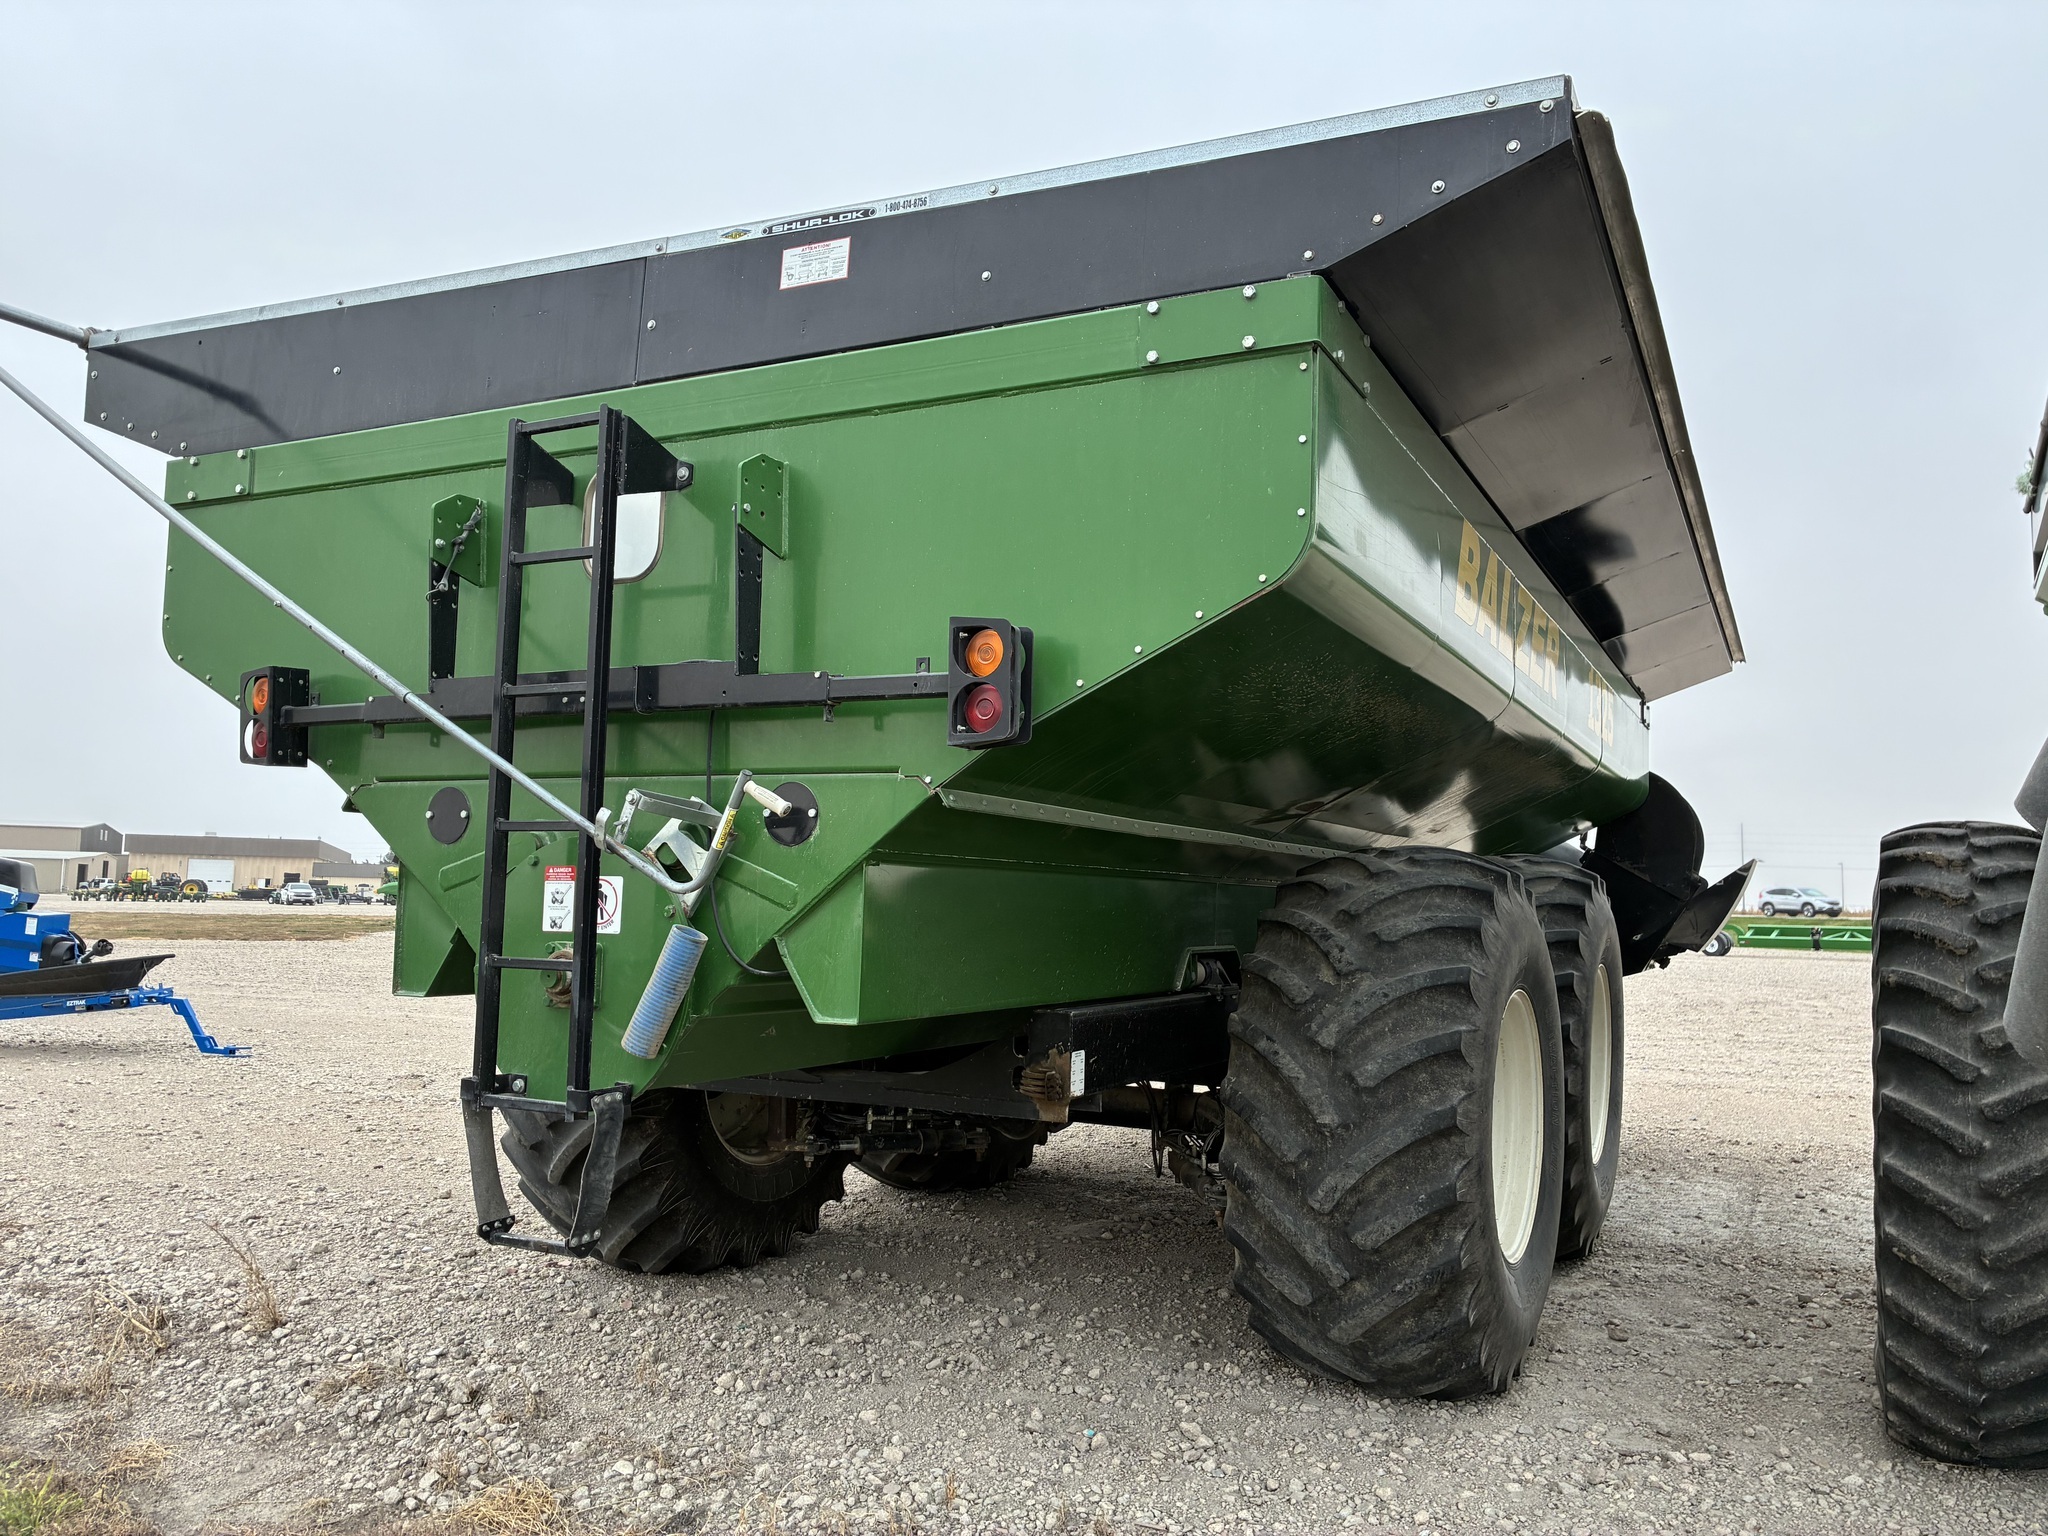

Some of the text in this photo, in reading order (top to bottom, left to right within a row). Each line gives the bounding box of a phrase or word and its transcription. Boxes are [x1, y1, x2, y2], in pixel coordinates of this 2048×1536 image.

[771, 209, 865, 234] SHUR-LOK
[884, 196, 928, 213] 1-800-474-8756
[1454, 518, 1559, 700] BALZER
[720, 819, 733, 841] CAUTION
[600, 919, 614, 931] ENTER
